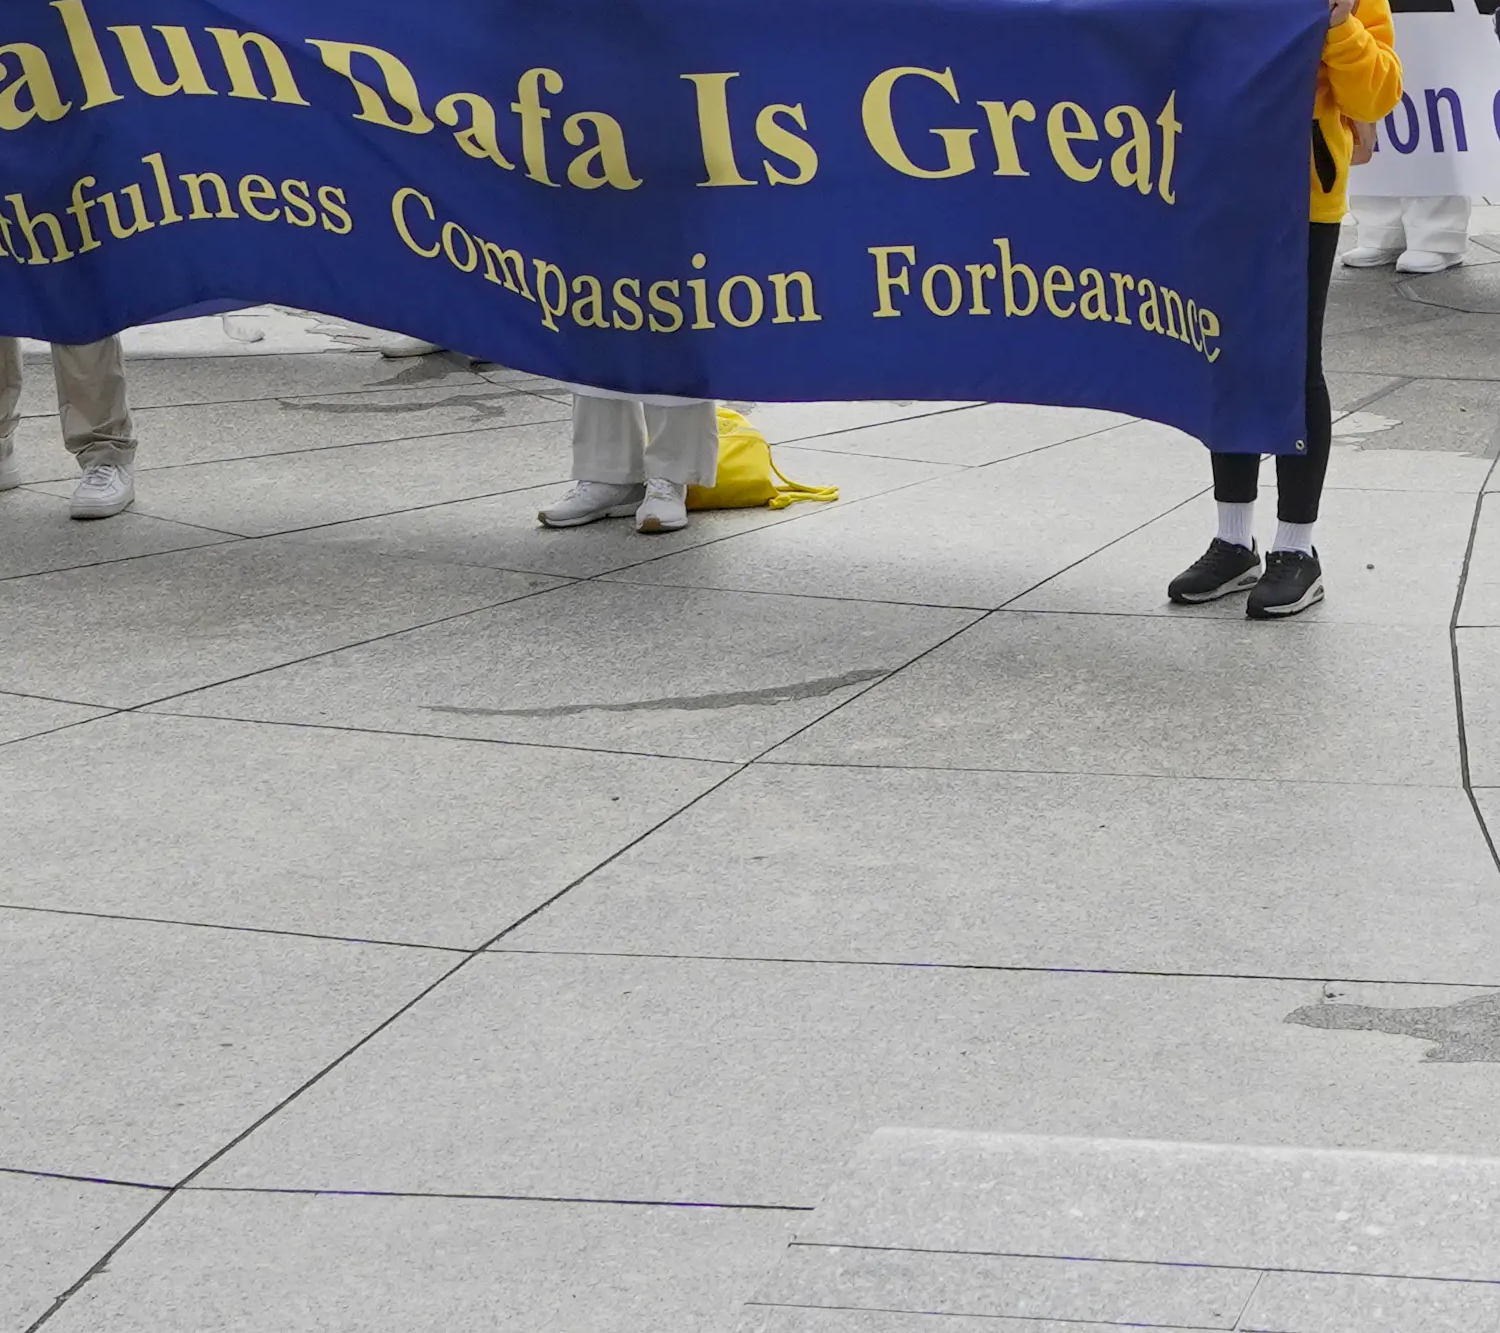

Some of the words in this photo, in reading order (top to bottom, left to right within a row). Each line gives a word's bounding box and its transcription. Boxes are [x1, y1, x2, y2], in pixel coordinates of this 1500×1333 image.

[305, 37, 639, 193] Dafa
[690, 72, 818, 187] Is
[861, 66, 1183, 204] Great
[390, 186, 820, 333] Compassion
[870, 239, 1222, 364] Forbearance
